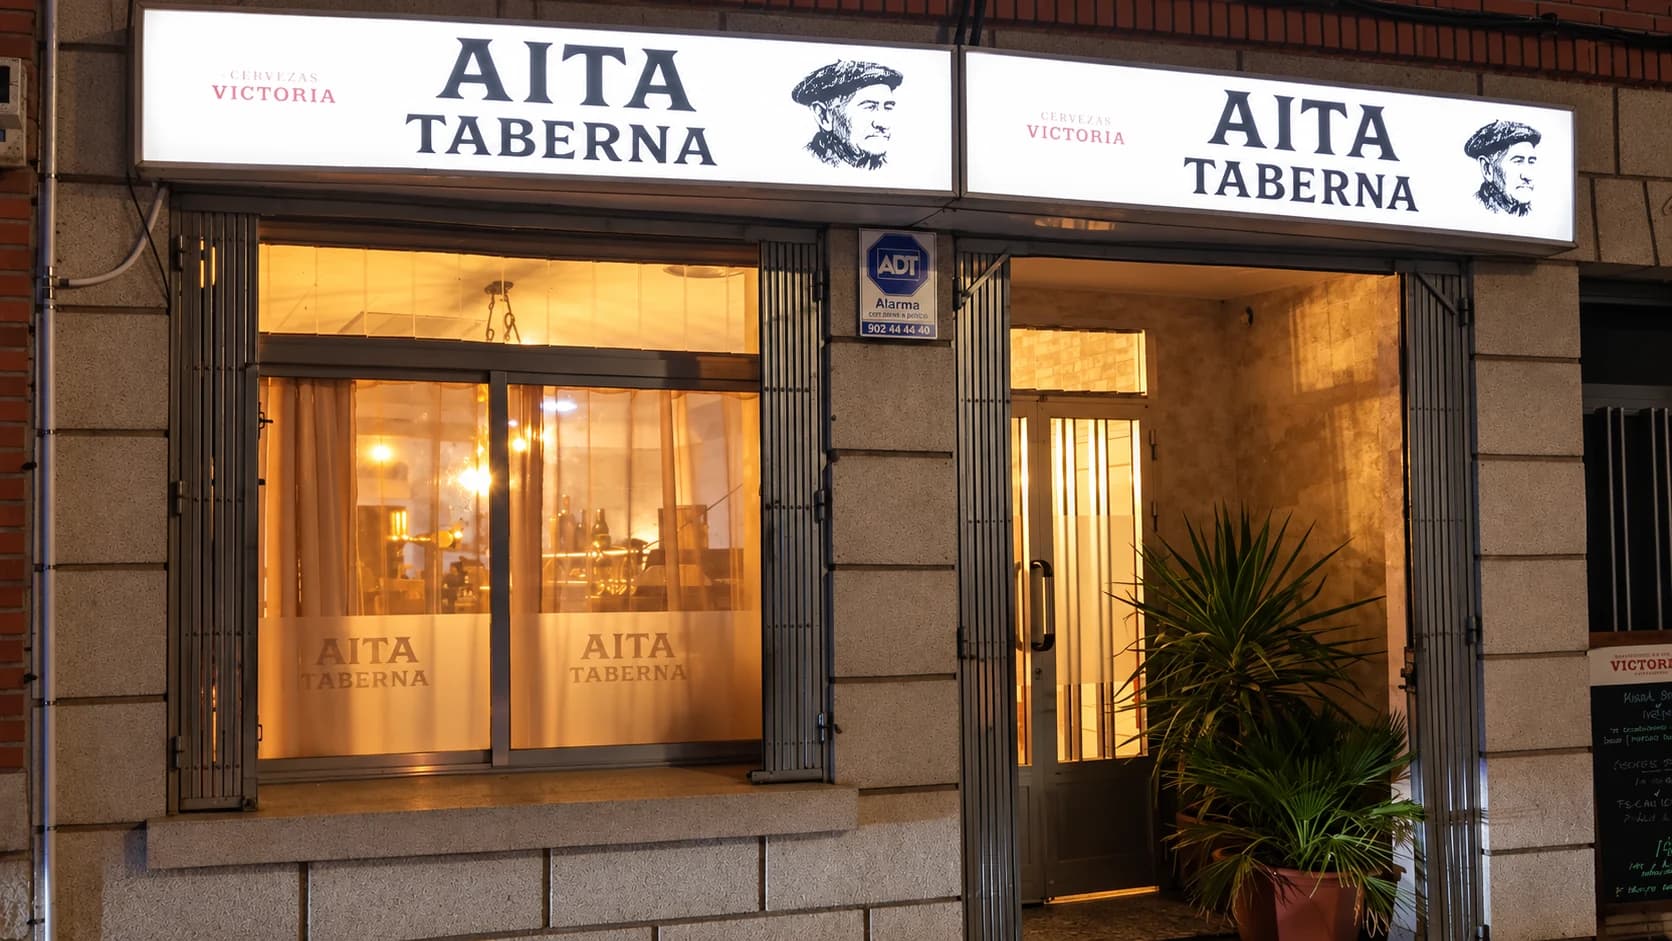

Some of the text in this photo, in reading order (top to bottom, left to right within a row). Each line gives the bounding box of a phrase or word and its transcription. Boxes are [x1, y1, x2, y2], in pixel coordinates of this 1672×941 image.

[230, 70, 318, 82] CERVEZAS
[436, 38, 696, 112] AITA
[211, 84, 336, 103] VICTORIA
[1040, 112, 1111, 126] CERVEZAS
[1208, 90, 1400, 161] AITA
[406, 114, 716, 165] TABERNA
[1026, 124, 1125, 144] VICTORIA
[1184, 158, 1418, 212] TABERNA
[878, 255, 918, 275] ADT
[876, 298, 919, 310] Alarma
[868, 324, 930, 335] 902 44 44 40
[315, 636, 420, 665] AITA
[580, 632, 676, 659] AITA
[301, 670, 430, 690] TABERNA
[569, 664, 688, 683] TABERNA
